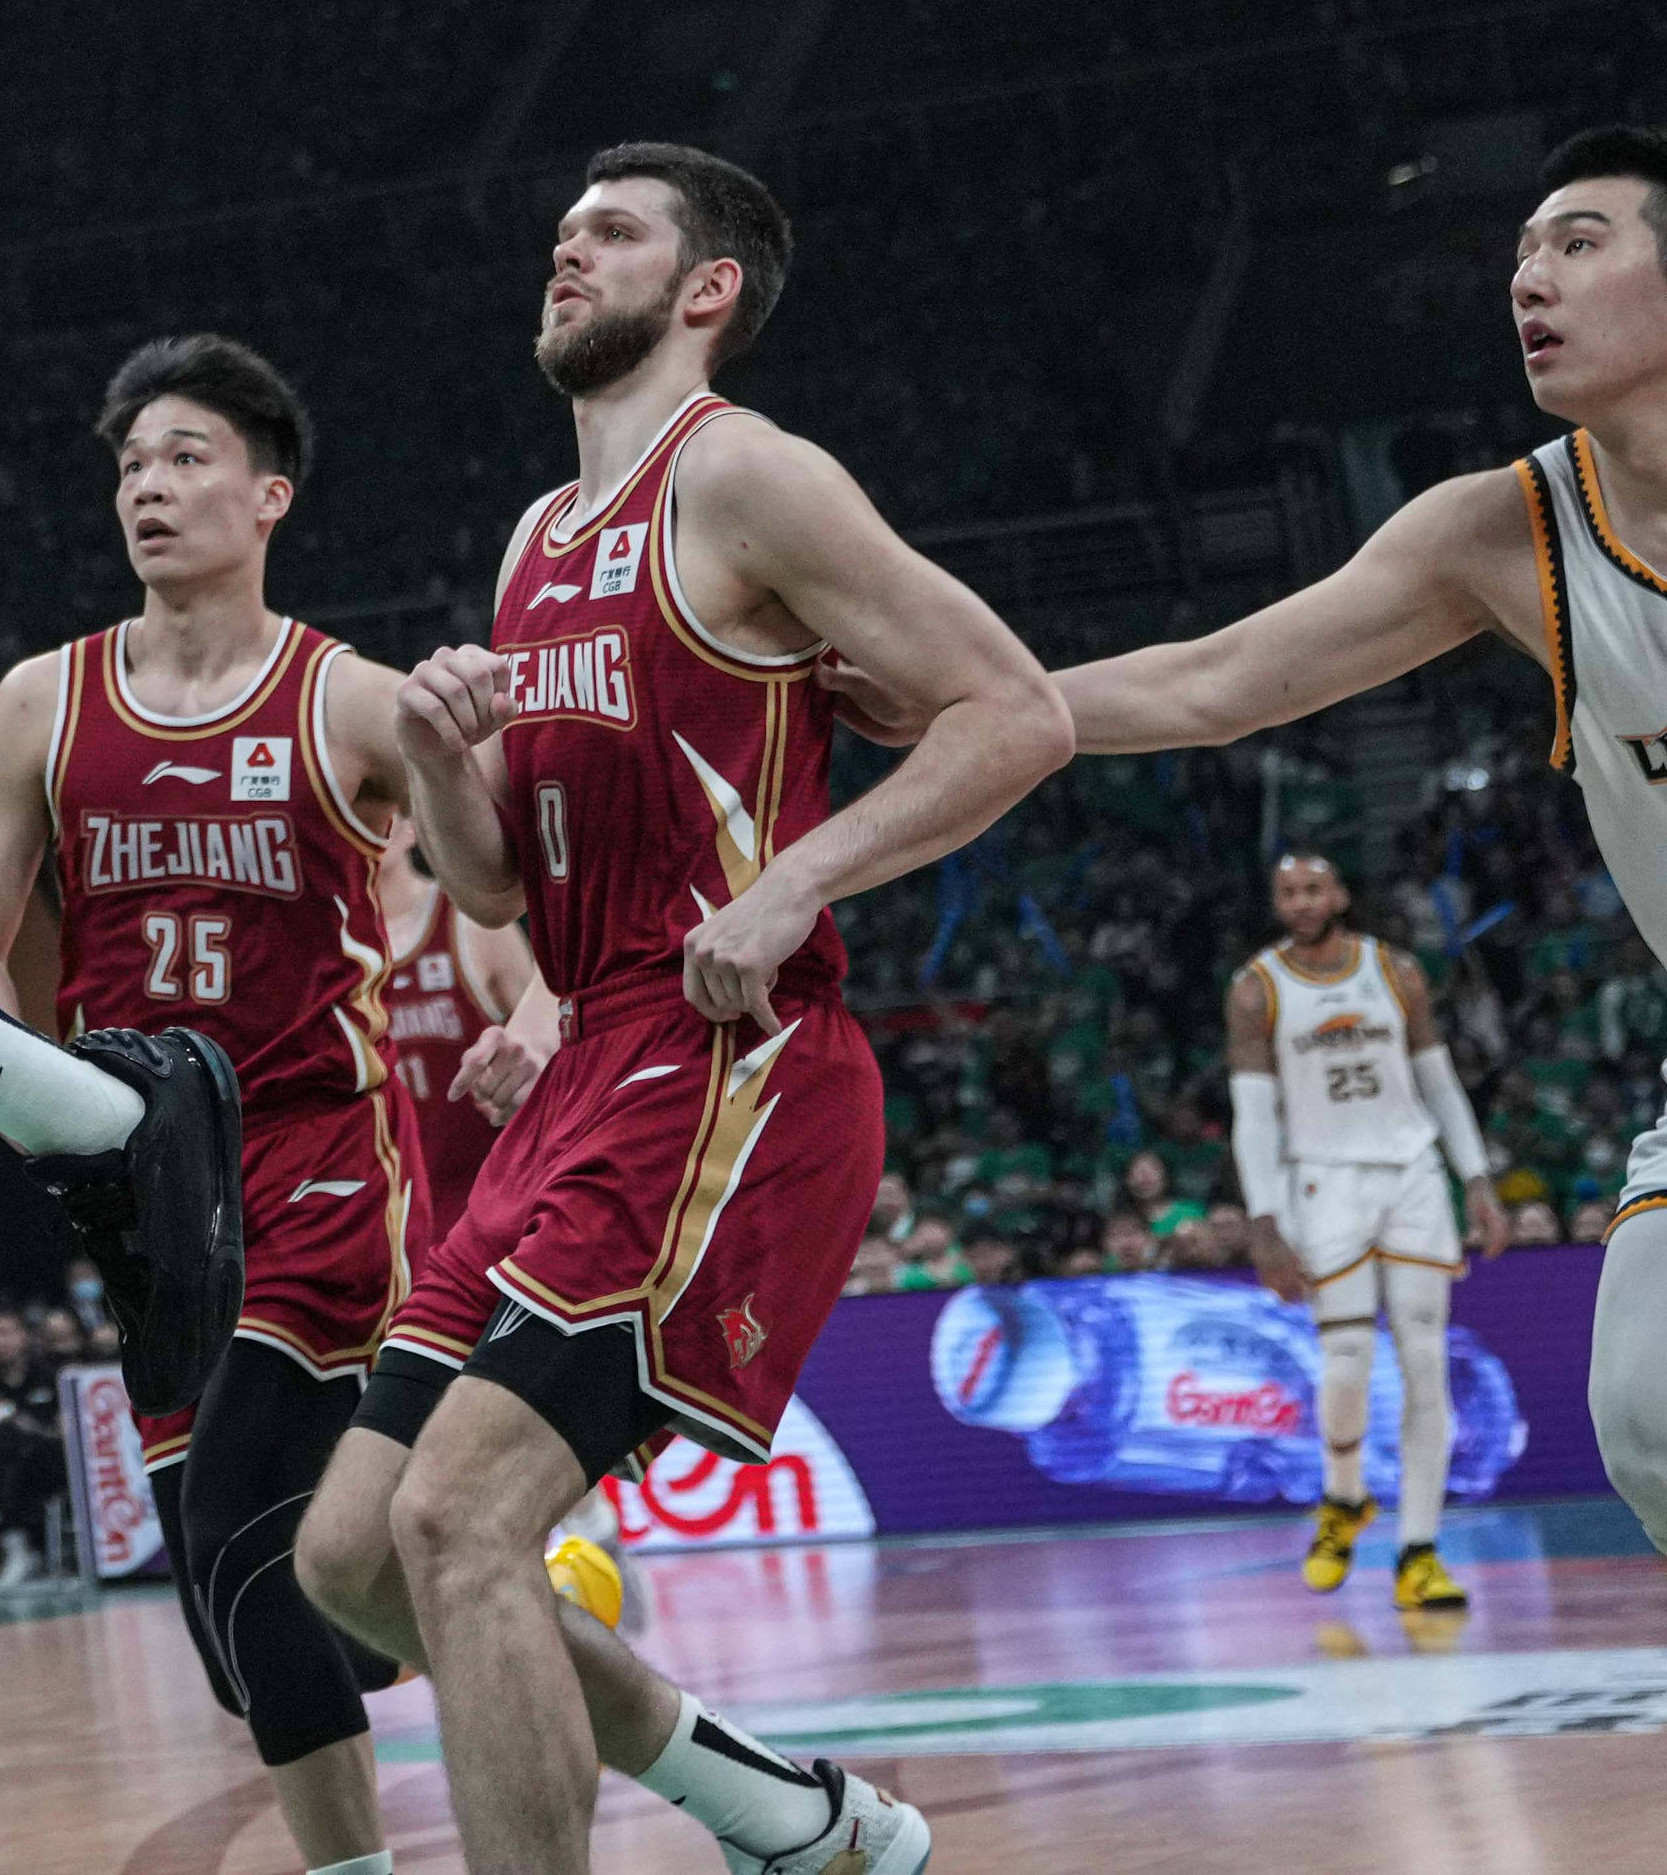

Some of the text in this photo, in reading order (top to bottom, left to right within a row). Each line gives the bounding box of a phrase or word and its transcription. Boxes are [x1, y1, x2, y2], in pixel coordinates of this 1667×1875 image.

[602, 580, 622, 594] CGB
[506, 633, 630, 722] EJIANG
[247, 787, 273, 799] CGB
[536, 781, 569, 881] 0
[85, 815, 298, 895] ZHEJIANG
[144, 913, 231, 1005] 25
[1326, 1061, 1383, 1104] 25
